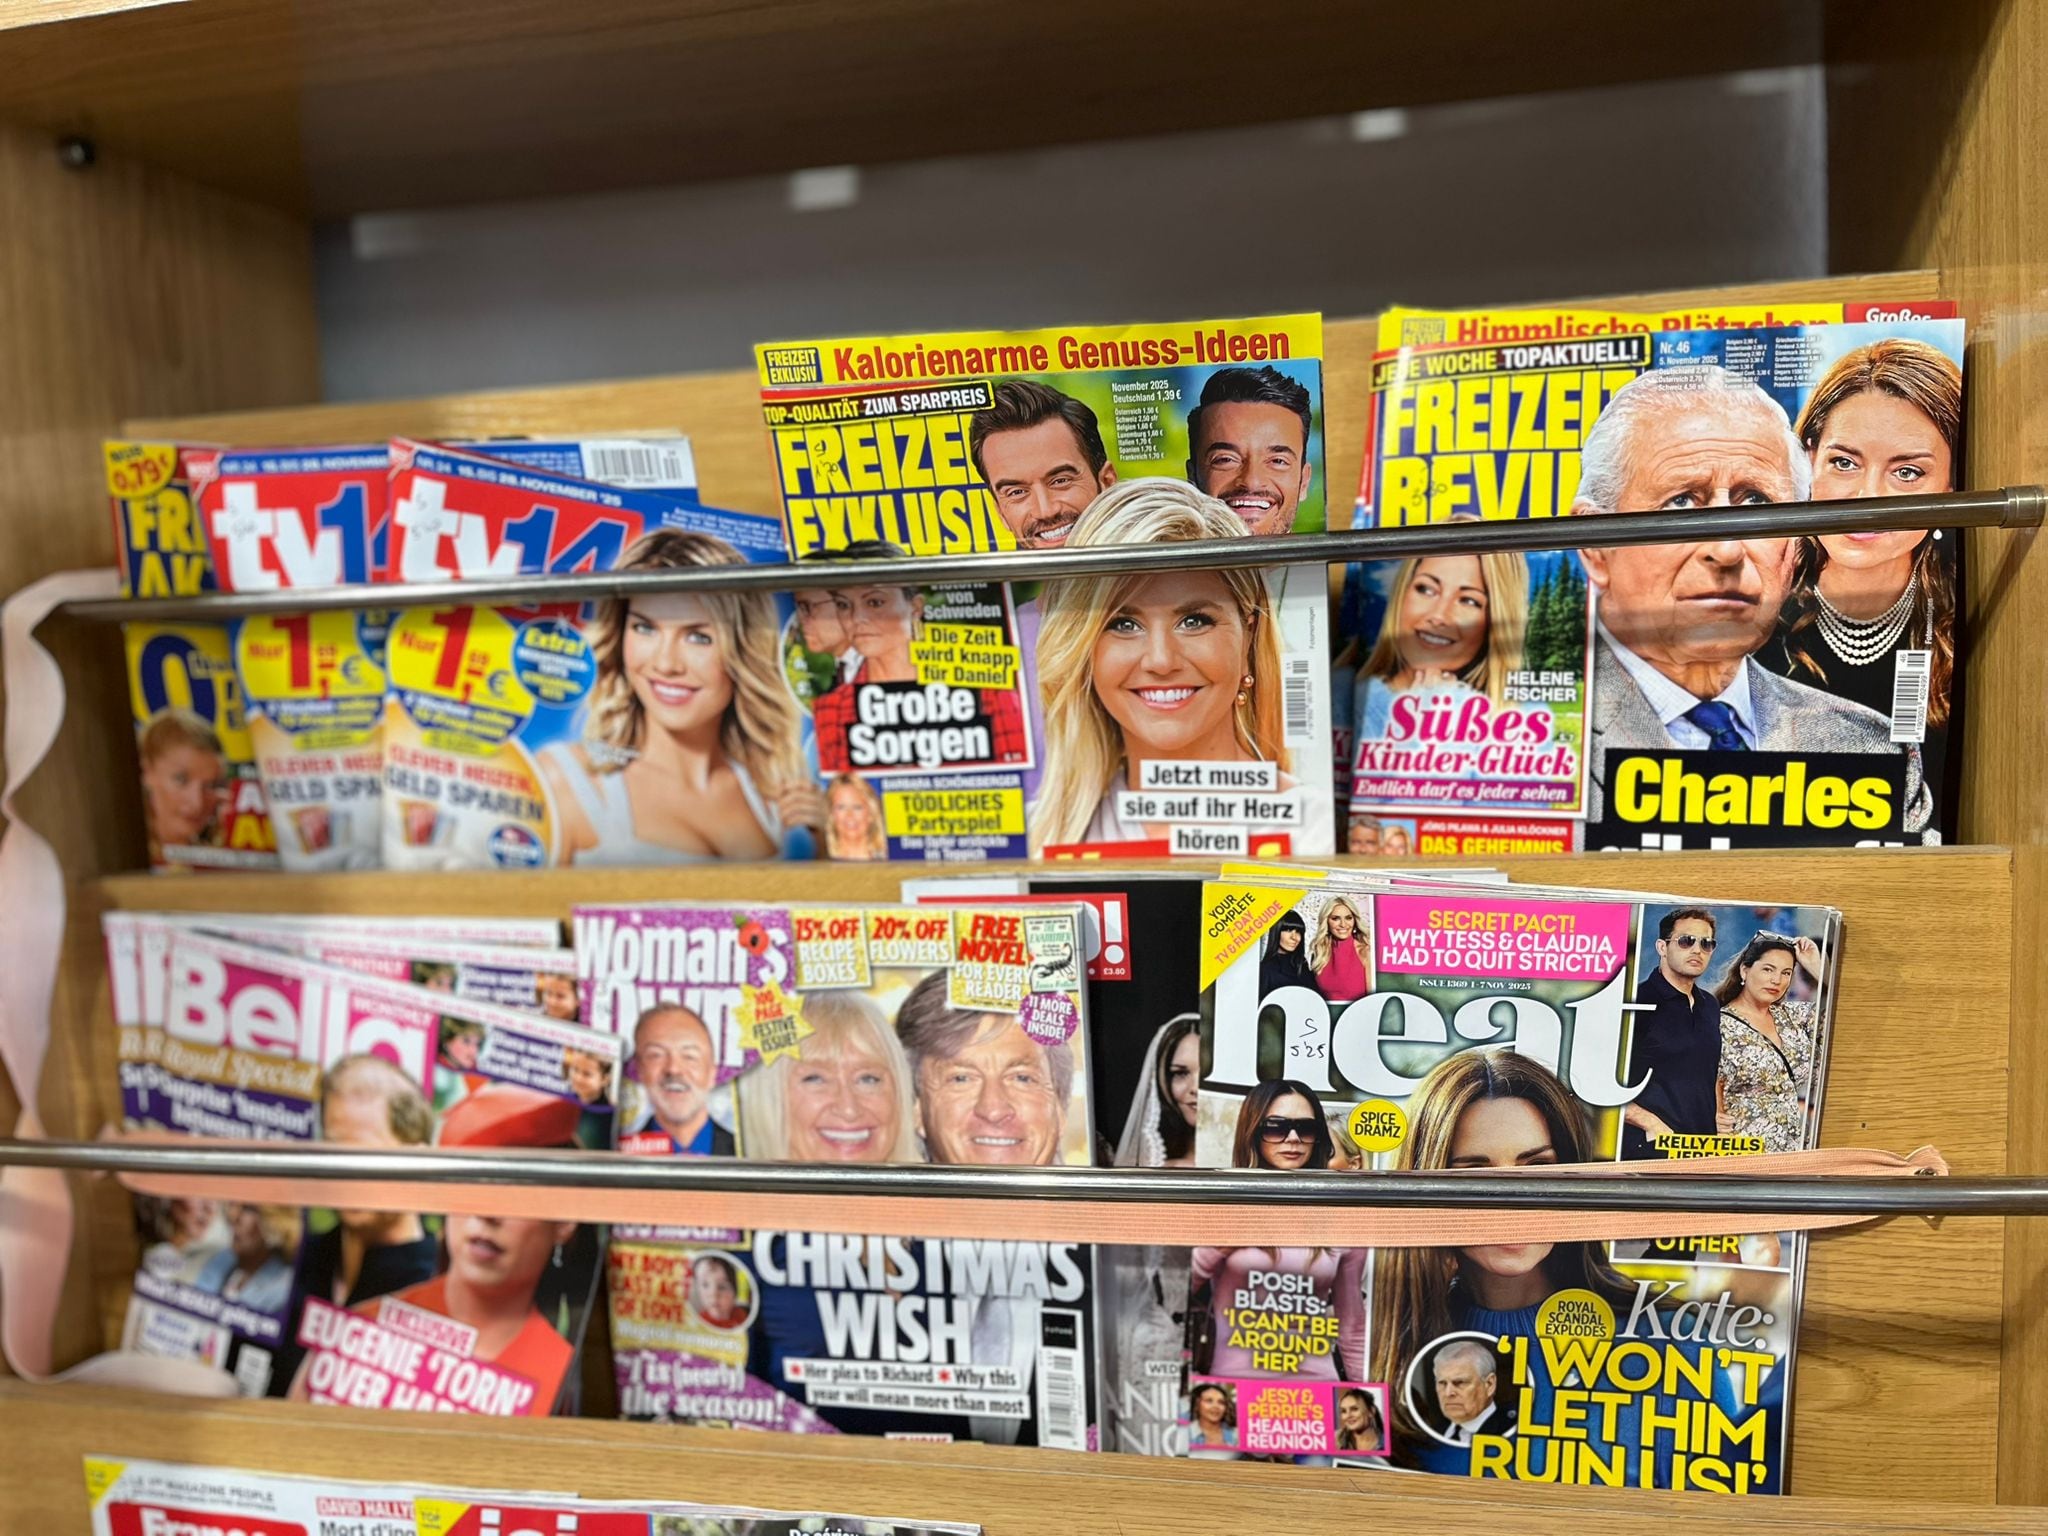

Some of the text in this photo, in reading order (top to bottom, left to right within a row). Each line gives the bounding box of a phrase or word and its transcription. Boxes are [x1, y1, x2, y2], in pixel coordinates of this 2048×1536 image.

[767, 349, 816, 367] FREIZEIT
[833, 329, 1289, 382] Kalorienarme Genuss-Ideen
[1427, 340, 1639, 377] WOCHE TOPAKTUELL!
[1660, 341, 1690, 354] Nr. 46
[1659, 355, 1718, 366] 5. November 2025
[771, 365, 817, 383] EXKLUSIV
[1112, 380, 1168, 392] November 2025
[1113, 389, 1182, 403] Deutschland 1,39 €
[764, 388, 986, 424] TOP-QUALITÄT ZUM SPARPREIS
[521, 476, 598, 502] NOVEMBER
[395, 477, 630, 582] tv14
[946, 591, 974, 604] von
[924, 603, 1001, 620] Schweden
[402, 629, 436, 655] Nur
[524, 627, 587, 657] Extra!
[931, 628, 996, 646] Die Zeit
[916, 646, 1013, 668] wird knapp
[924, 664, 1007, 685] für Daniel
[1506, 671, 1575, 687] HELENE
[858, 683, 975, 727] Große
[1503, 686, 1577, 702] FISCHER
[1386, 695, 1551, 745] Süßes
[850, 723, 990, 769] Sorgen
[1357, 741, 1575, 776] Kinder-Glück
[1148, 764, 1269, 786] Jetzt muss
[447, 782, 545, 822] SPAREN
[901, 792, 1004, 812] TÖDLICHES
[1356, 779, 1568, 802] Endlich darf es jeder sehen
[1614, 756, 1893, 830] Charles
[1125, 797, 1294, 819] sie auf ihr Herz
[907, 813, 1002, 834] Partyspiel
[1421, 820, 1446, 832] JÖRG
[1517, 824, 1568, 836] KLÖCKNER
[1177, 828, 1240, 851] hören
[1420, 835, 1565, 855] DAS GEHEIMNIS
[1208, 892, 1256, 938] COMPLETE
[1209, 894, 1237, 919] YOUR
[796, 918, 859, 941] 15% OFF
[873, 916, 949, 940] 20% OFF
[971, 913, 1020, 940] FREE
[1214, 900, 1284, 965] TV & FILM GUIDE
[1226, 910, 1255, 937] 7-DAY
[1429, 910, 1576, 935] SECRET PACT!
[798, 942, 856, 961] RECIPE
[869, 942, 950, 961] FLOWERS
[1388, 928, 1614, 954] WHY TESS & CLAUDIA
[1103, 967, 1126, 977] £3.80
[1382, 947, 1618, 974] HAD TO QUIT STRICTLY
[803, 962, 857, 983] BOXES
[955, 963, 1033, 986] FOR EVERY
[965, 981, 1023, 1000] READER
[1419, 978, 1447, 988] ISSUE
[1486, 981, 1507, 990] NOV
[1508, 981, 1531, 991] 2025
[1028, 995, 1039, 1009] 11
[1040, 998, 1073, 1015] MORE
[168, 949, 430, 1101] Bella
[753, 1014, 797, 1038] FESTIVE
[1031, 1009, 1066, 1026] DEALS
[1203, 938, 1657, 1108] heat
[761, 1030, 800, 1052] ISSUE!
[1027, 1019, 1067, 1041] INSIDE!
[231, 1052, 319, 1093] Special
[1360, 1110, 1397, 1125] SPICE
[1355, 1122, 1401, 1139] DRAMZ
[1658, 1136, 1761, 1151] KELLY TELLS
[753, 1231, 1085, 1302] CHRISTMAS
[1248, 1270, 1314, 1295] POSH
[1234, 1290, 1327, 1315] BLASTS:
[1557, 1300, 1597, 1315] ROYAL
[1223, 1309, 1340, 1338] ‘I CAN'T BE
[1548, 1312, 1604, 1327] SCANDAL
[1615, 1279, 1776, 1351] Kate:
[815, 1290, 973, 1364] WISH
[1544, 1324, 1607, 1339] EXPLODES
[301, 1300, 427, 1382] EUGENIE
[1227, 1329, 1330, 1355] AROUND
[1252, 1351, 1305, 1373] HER’
[1496, 1335, 1776, 1406] ‘I WON’T
[309, 1350, 391, 1407] OVER
[805, 1365, 1017, 1388] Her plea to Richard Why this
[621, 1384, 787, 1423] the season!
[812, 1387, 1024, 1414] year will mean more than most
[1255, 1388, 1314, 1404] JESY &
[1247, 1402, 1324, 1420] PERRIE'S
[1247, 1418, 1326, 1435] HEALING
[1516, 1386, 1768, 1463] LET HIM
[1246, 1433, 1328, 1451] REUNION
[1469, 1434, 1626, 1489] RUIN
[231, 1486, 275, 1503] PEOPLE
[318, 1497, 362, 1517] DAVID
[320, 1521, 364, 1536] Mort
